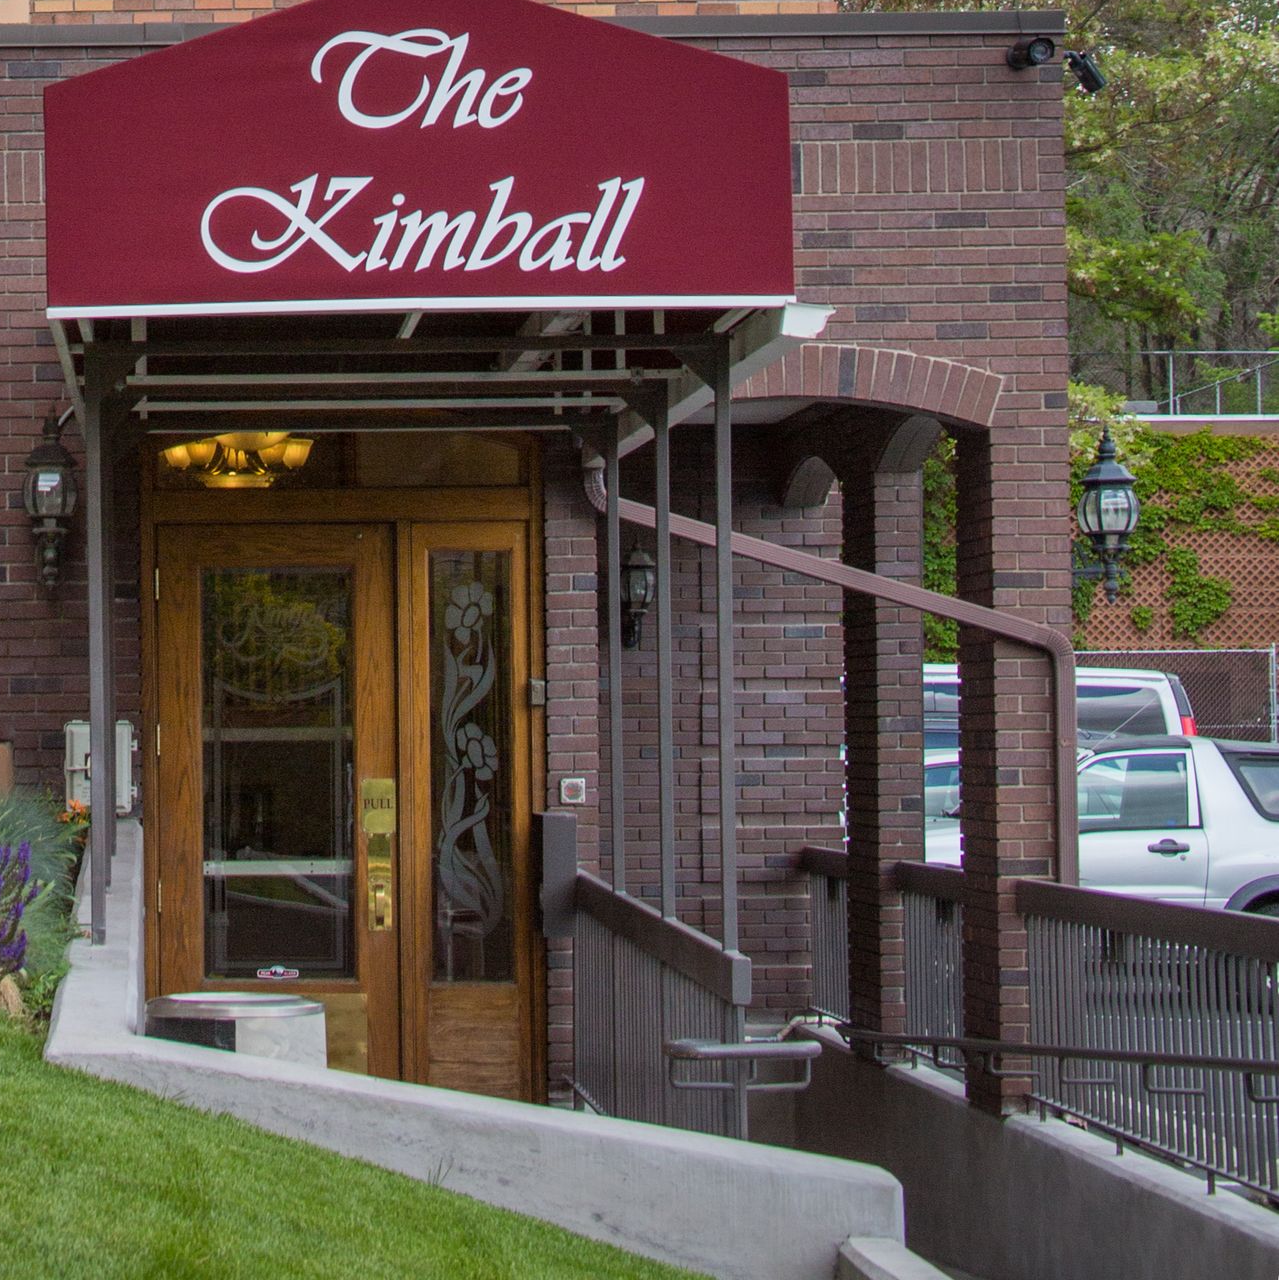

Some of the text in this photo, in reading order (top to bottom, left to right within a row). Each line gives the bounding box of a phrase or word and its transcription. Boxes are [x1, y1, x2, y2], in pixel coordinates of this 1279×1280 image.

[311, 29, 532, 129] The
[201, 174, 644, 273] Kimball
[363, 798, 393, 809] PULL
